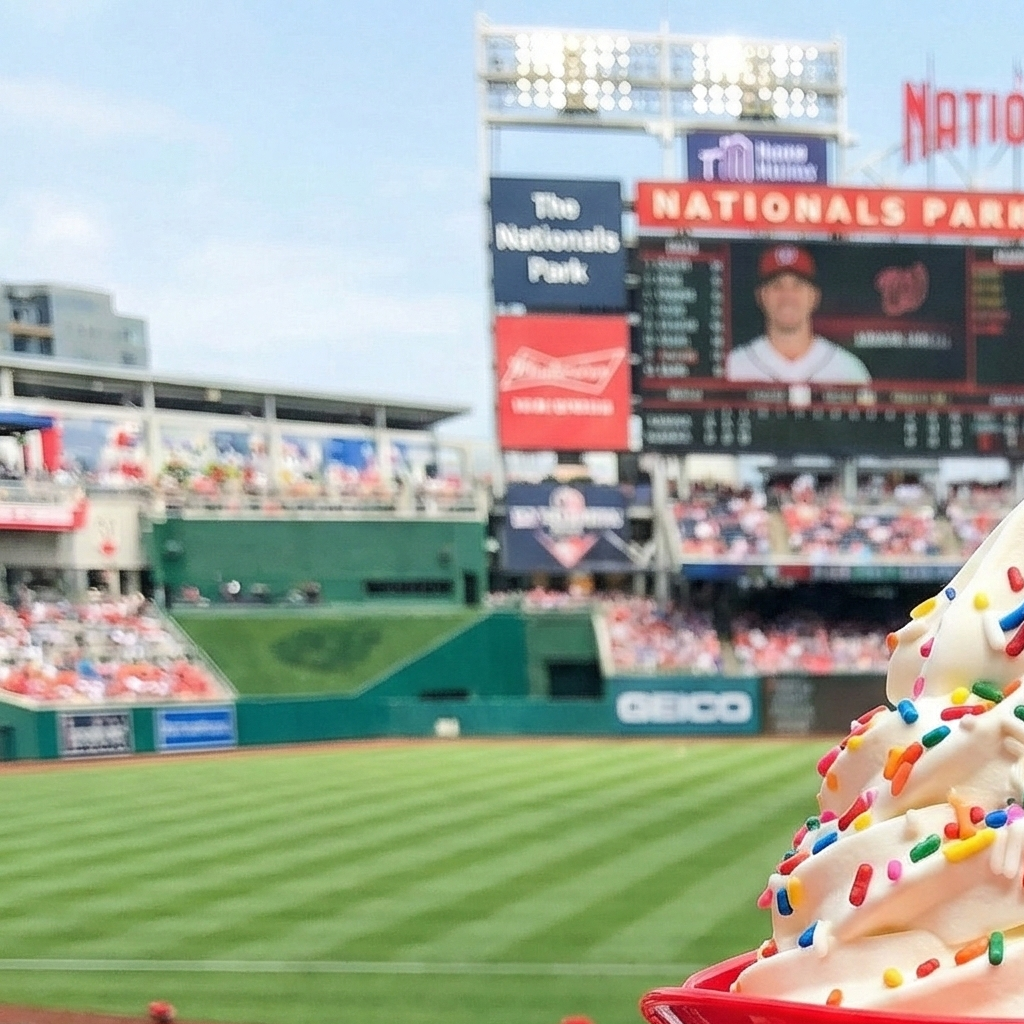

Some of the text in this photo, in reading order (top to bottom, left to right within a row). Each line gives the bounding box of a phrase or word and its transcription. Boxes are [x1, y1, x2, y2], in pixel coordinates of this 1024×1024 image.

[530, 190, 581, 221] The
[652, 187, 907, 227] NATIONALS
[495, 222, 621, 253] Nationals
[527, 255, 590, 285] Park
[615, 690, 754, 725] GEICO
